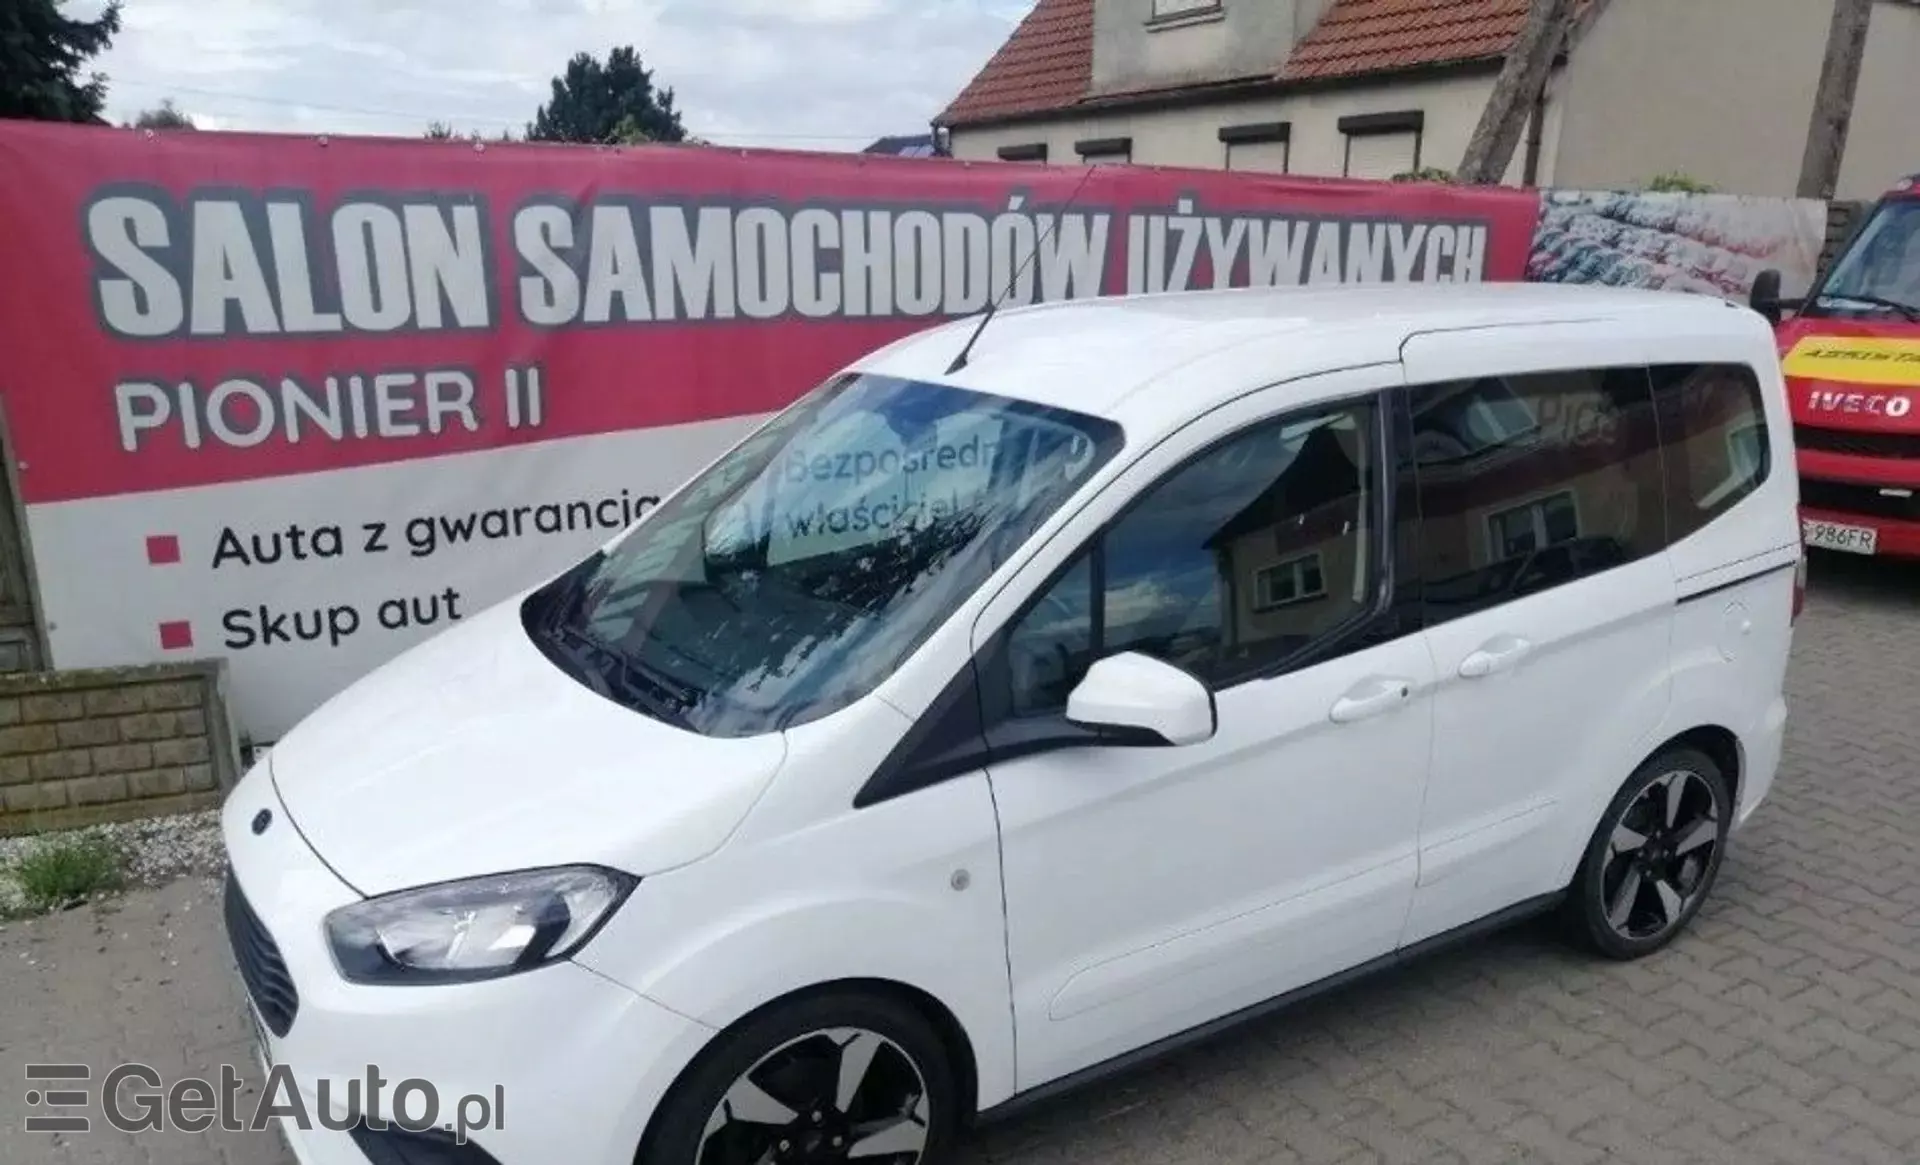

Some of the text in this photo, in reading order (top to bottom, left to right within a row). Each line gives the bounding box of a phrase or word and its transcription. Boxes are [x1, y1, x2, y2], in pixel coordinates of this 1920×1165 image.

[86, 195, 1488, 338] SALON SAMOCHODÓW UŻYWANYCH
[114, 365, 543, 453] PIONIER II
[1807, 390, 1912, 418] IVECO
[211, 522, 344, 570] Auta
[362, 519, 390, 554] z
[221, 586, 463, 650] Skup aut
